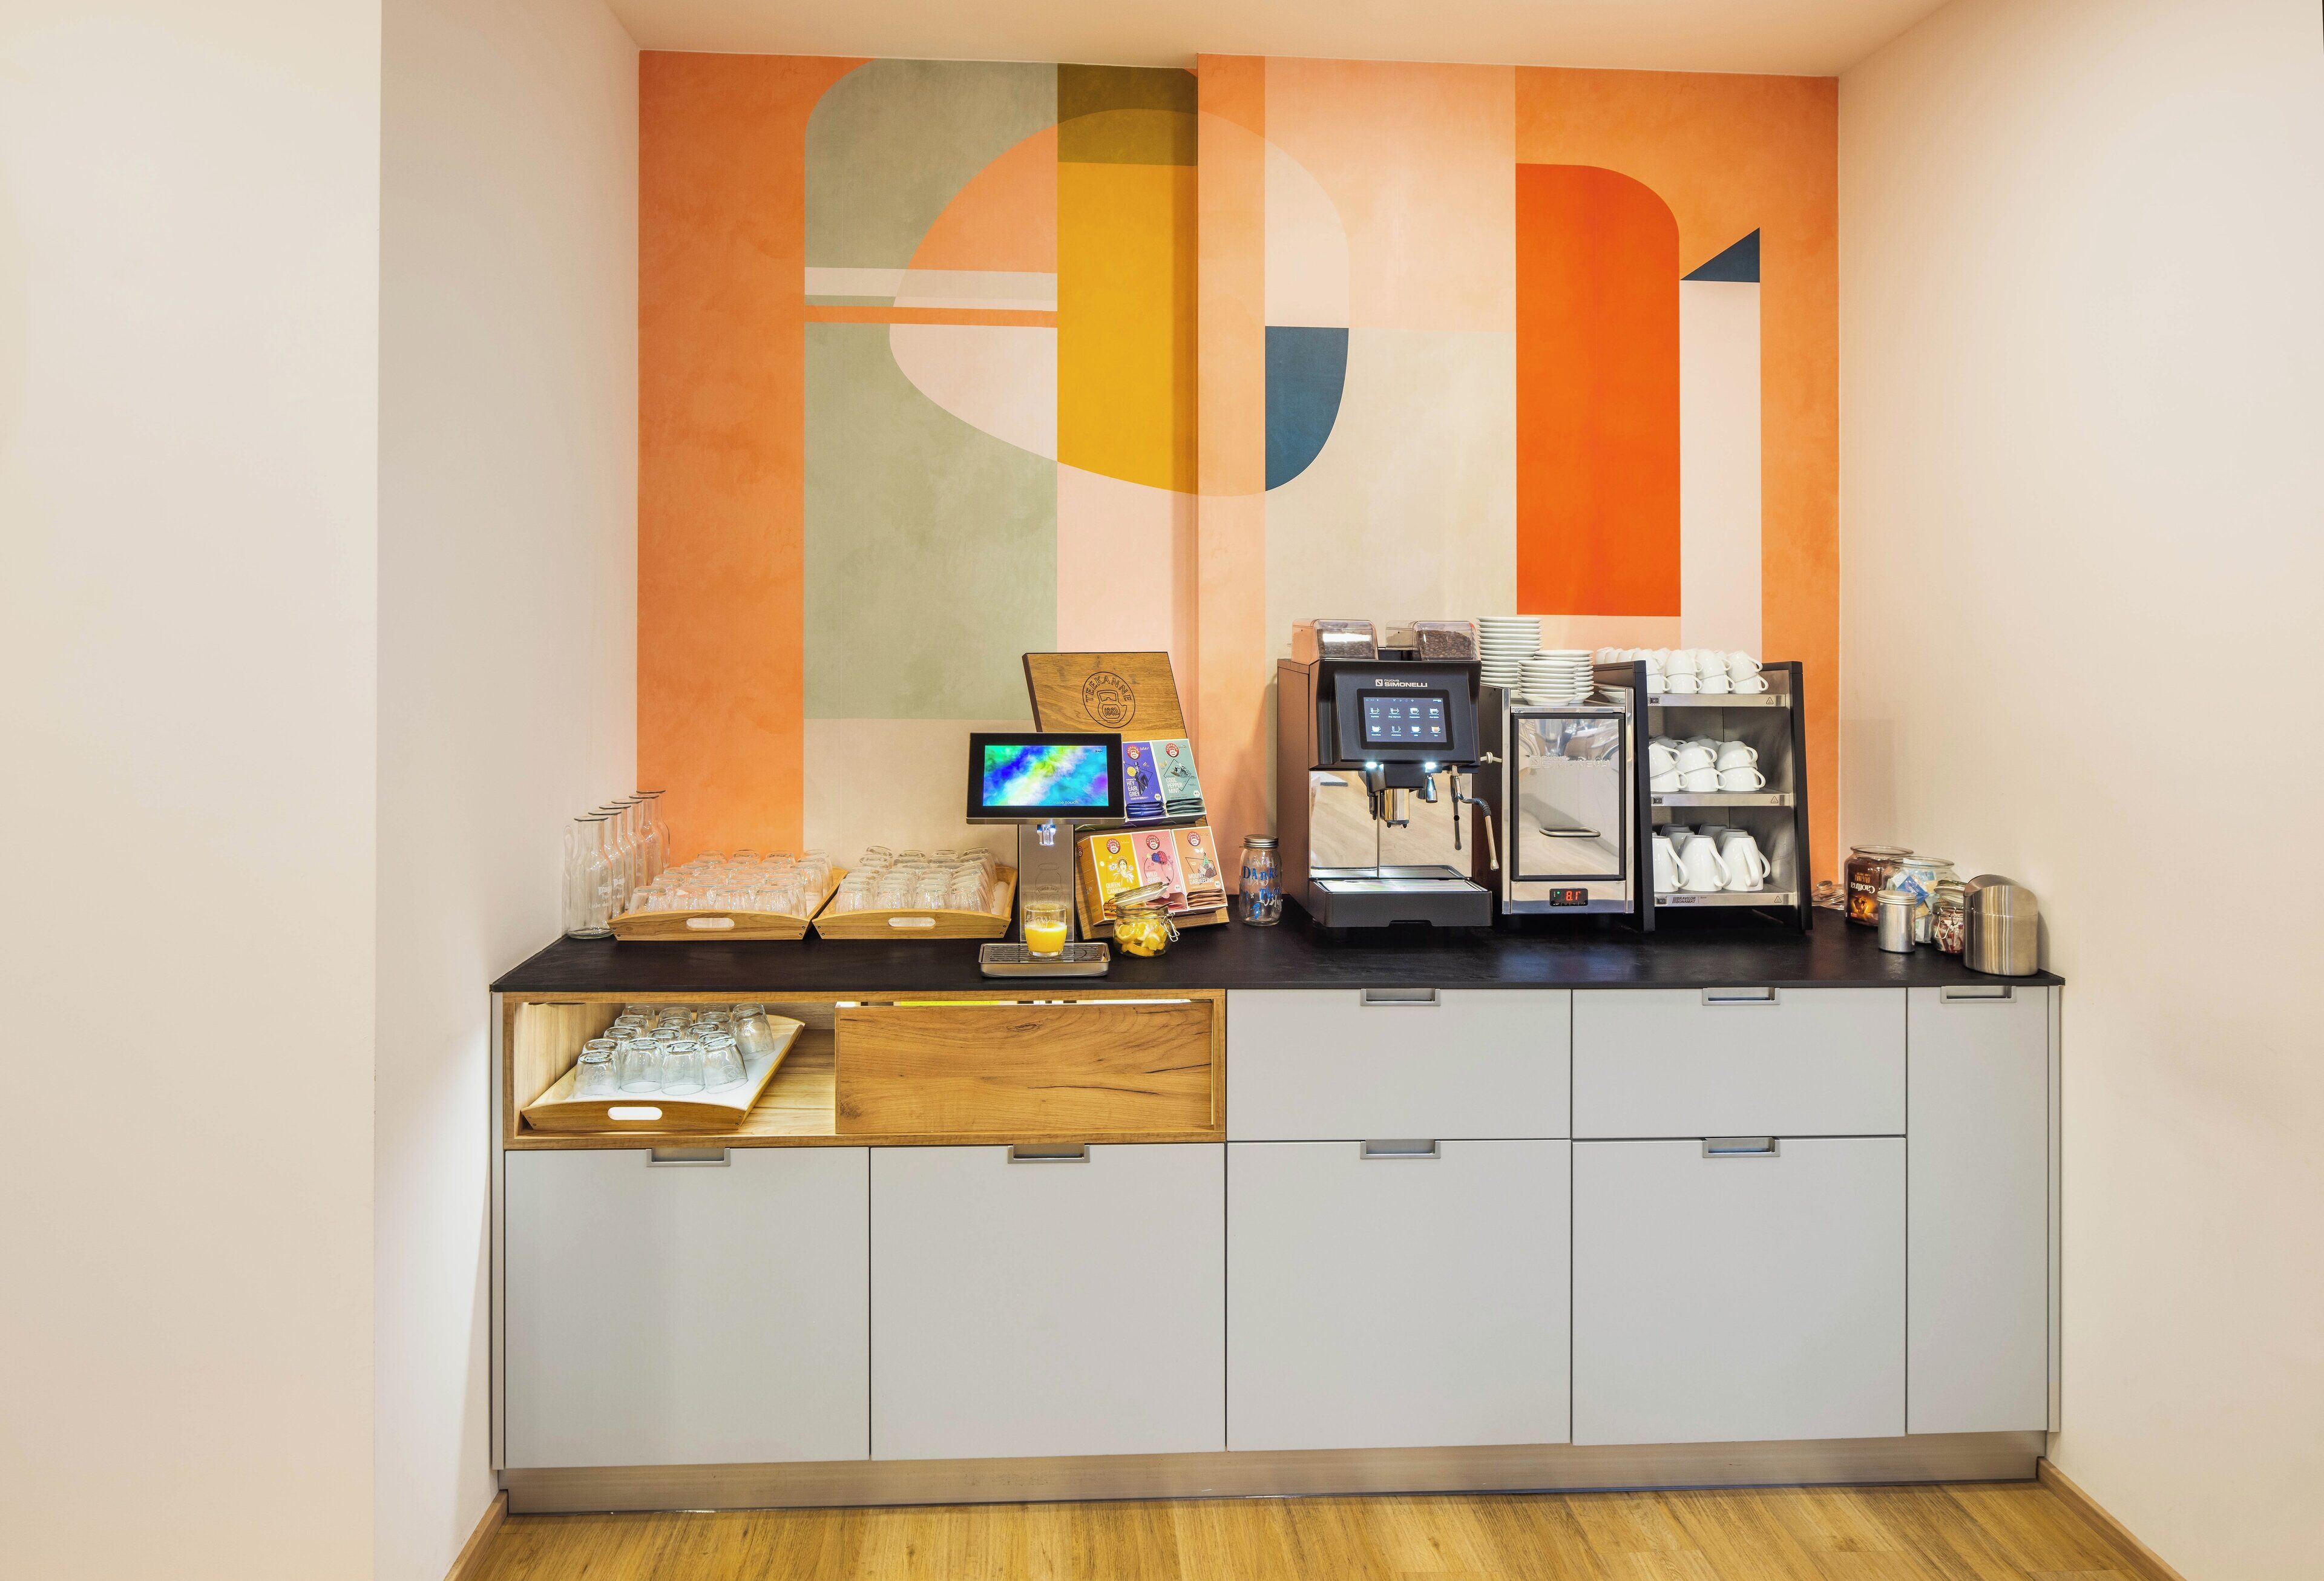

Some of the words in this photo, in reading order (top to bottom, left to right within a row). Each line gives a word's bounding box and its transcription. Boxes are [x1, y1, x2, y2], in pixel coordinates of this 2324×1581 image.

[1085, 675, 1132, 702] TEEKANNE
[1105, 708, 1120, 716] 1882
[1851, 882, 1876, 894] Caotina
